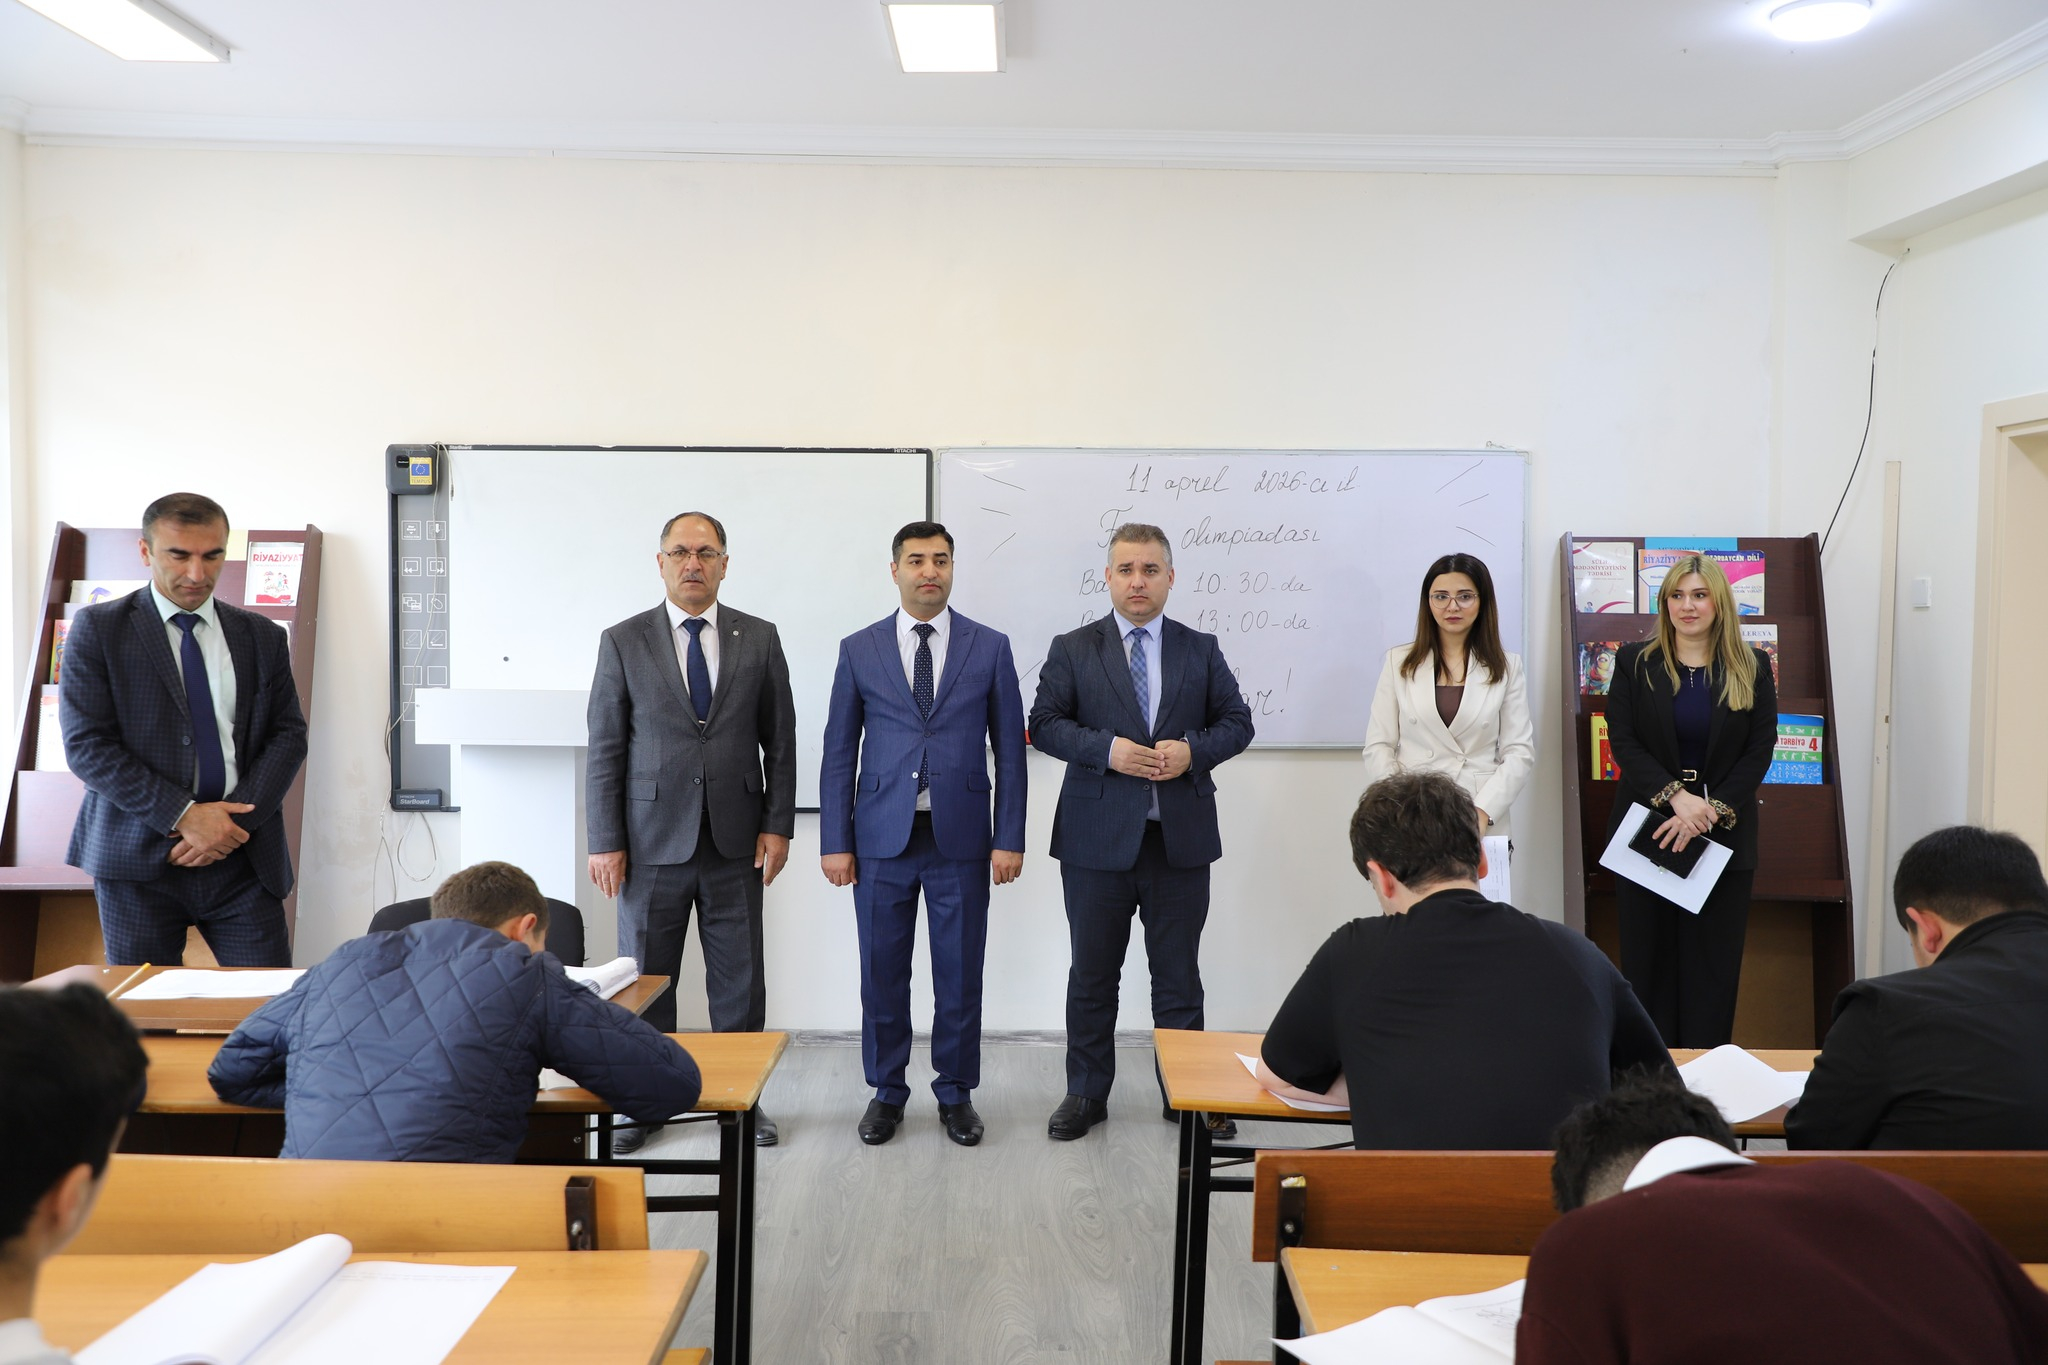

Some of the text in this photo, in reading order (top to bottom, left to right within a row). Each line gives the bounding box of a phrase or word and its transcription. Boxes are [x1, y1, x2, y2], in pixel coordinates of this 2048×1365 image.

[1126, 463, 1152, 492] 11
[1164, 465, 1230, 500] aprel
[253, 551, 304, 562] RİYAZİYYAT
[1643, 554, 1684, 564] RİYAZİYY
[1780, 736, 1805, 746] TƏRBİYƏ
[1809, 737, 1818, 751] 4
